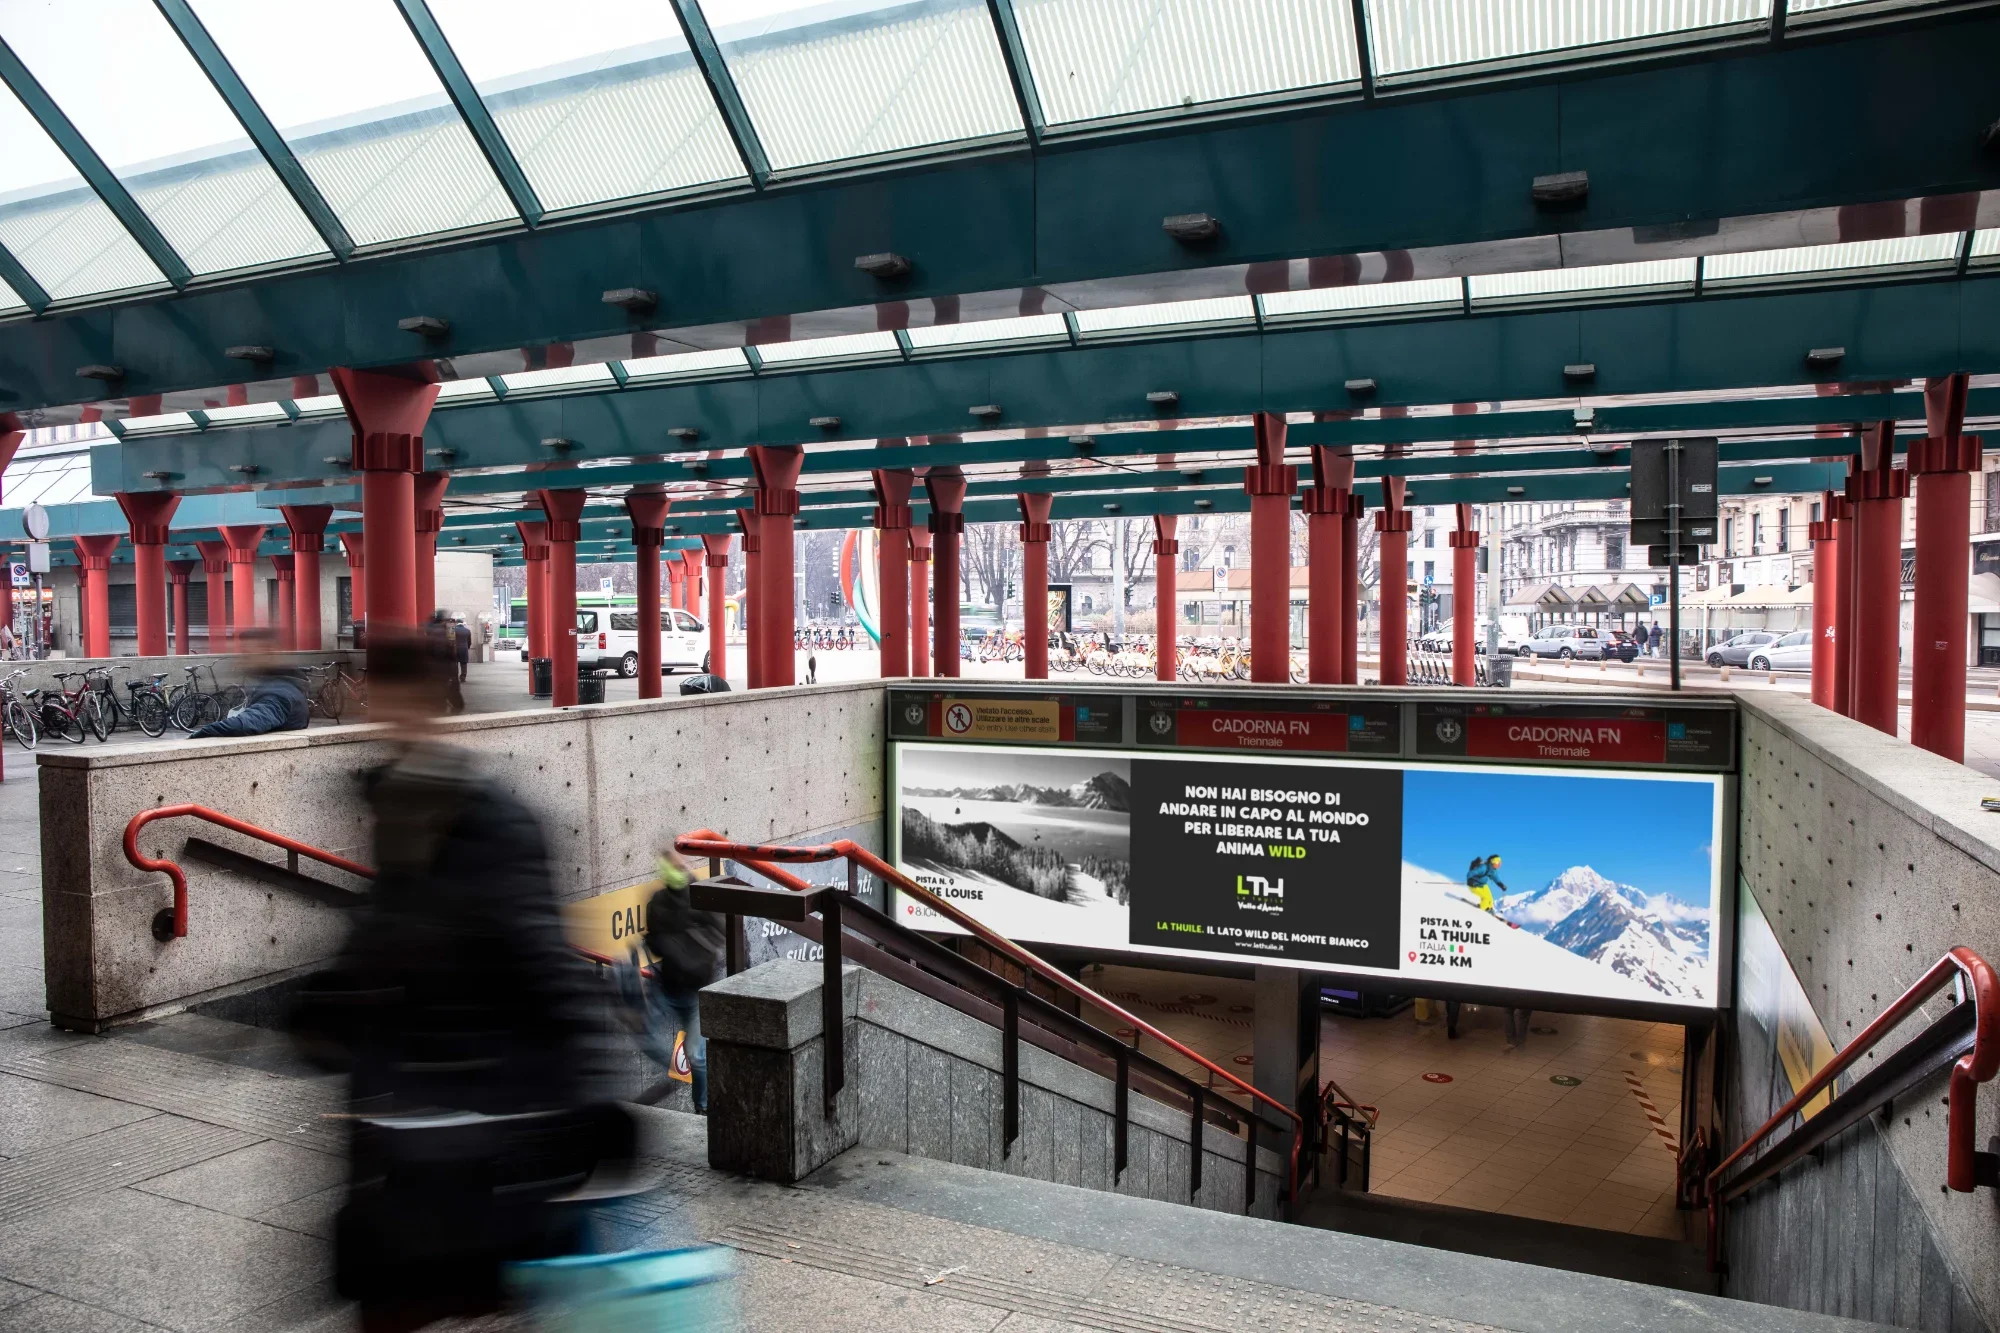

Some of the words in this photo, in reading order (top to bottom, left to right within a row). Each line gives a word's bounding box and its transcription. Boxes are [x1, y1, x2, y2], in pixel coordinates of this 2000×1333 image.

[976, 715, 1006, 723] Utilizzare
[1014, 716, 1030, 724] altre
[1212, 718, 1286, 735] CADORNA
[1290, 721, 1310, 735] FN
[1038, 726, 1056, 734] stairs
[1508, 726, 1594, 743] CADORNA
[1598, 728, 1621, 744] FN
[1237, 736, 1283, 747] Triennale
[1538, 745, 1590, 757] Triennale
[1185, 786, 1217, 799] NON
[1221, 788, 1246, 800] HAI
[1250, 789, 1321, 804] BISOGNO
[1325, 792, 1340, 805] DI
[1159, 802, 1217, 817] ANDARE
[1220, 806, 1235, 818] IN
[1240, 806, 1282, 821] CAPO
[1286, 809, 1304, 822] AL
[1309, 810, 1369, 826] MONDO
[1184, 822, 1211, 835] PER
[1215, 823, 1283, 840] LIBERARE
[1287, 828, 1305, 841] LA
[1309, 829, 1341, 843] TUA
[1216, 842, 1264, 856] ANIMA
[1268, 845, 1306, 858] WILD
[916, 876, 937, 884] PISTA
[949, 878, 954, 886] 9
[1237, 875, 1284, 898] LTH
[945, 888, 983, 900] LOUISE
[1238, 901, 1256, 910] Valle
[612, 904, 647, 940] CAL
[1420, 917, 1449, 927] PISTA
[1452, 919, 1462, 928] N.
[1465, 921, 1472, 929] 9
[1157, 921, 1168, 931] LA
[1171, 922, 1204, 934] THUILE.
[1207, 926, 1215, 935] IL
[1217, 927, 1242, 937] LATO
[1244, 929, 1269, 940] WILD
[1271, 931, 1289, 941] DEL
[1291, 933, 1326, 945] MONTE
[1329, 937, 1369, 948] BIANCO
[1420, 928, 1437, 940] LA
[1441, 930, 1490, 945] THUILE
[1235, 941, 1284, 951] www.lathuile.it
[1420, 941, 1446, 951] ITALIA
[1420, 953, 1445, 965] 224
[1450, 956, 1472, 968] KM
